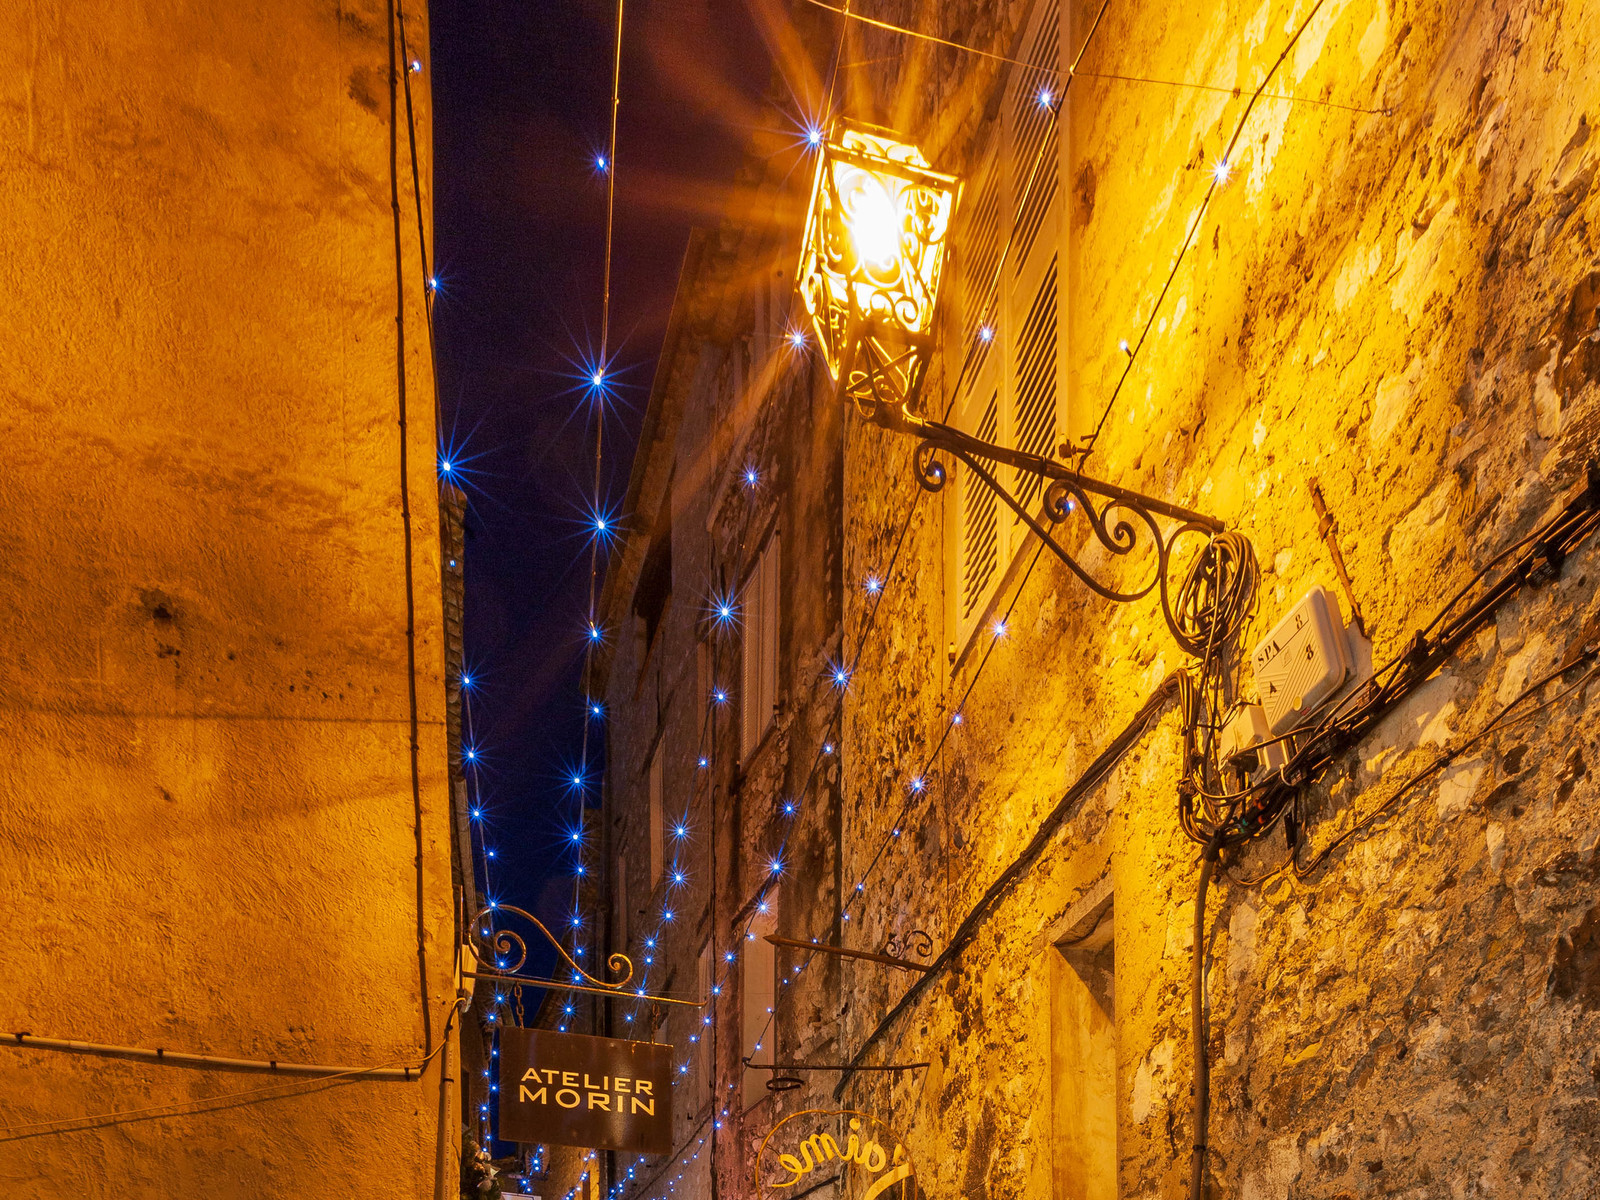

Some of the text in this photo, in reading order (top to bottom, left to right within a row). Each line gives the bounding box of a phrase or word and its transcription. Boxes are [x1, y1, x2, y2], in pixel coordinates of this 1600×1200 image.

[1257, 640, 1281, 667] SPA
[520, 1067, 654, 1096] ATELIER
[519, 1084, 655, 1117] MORIN
